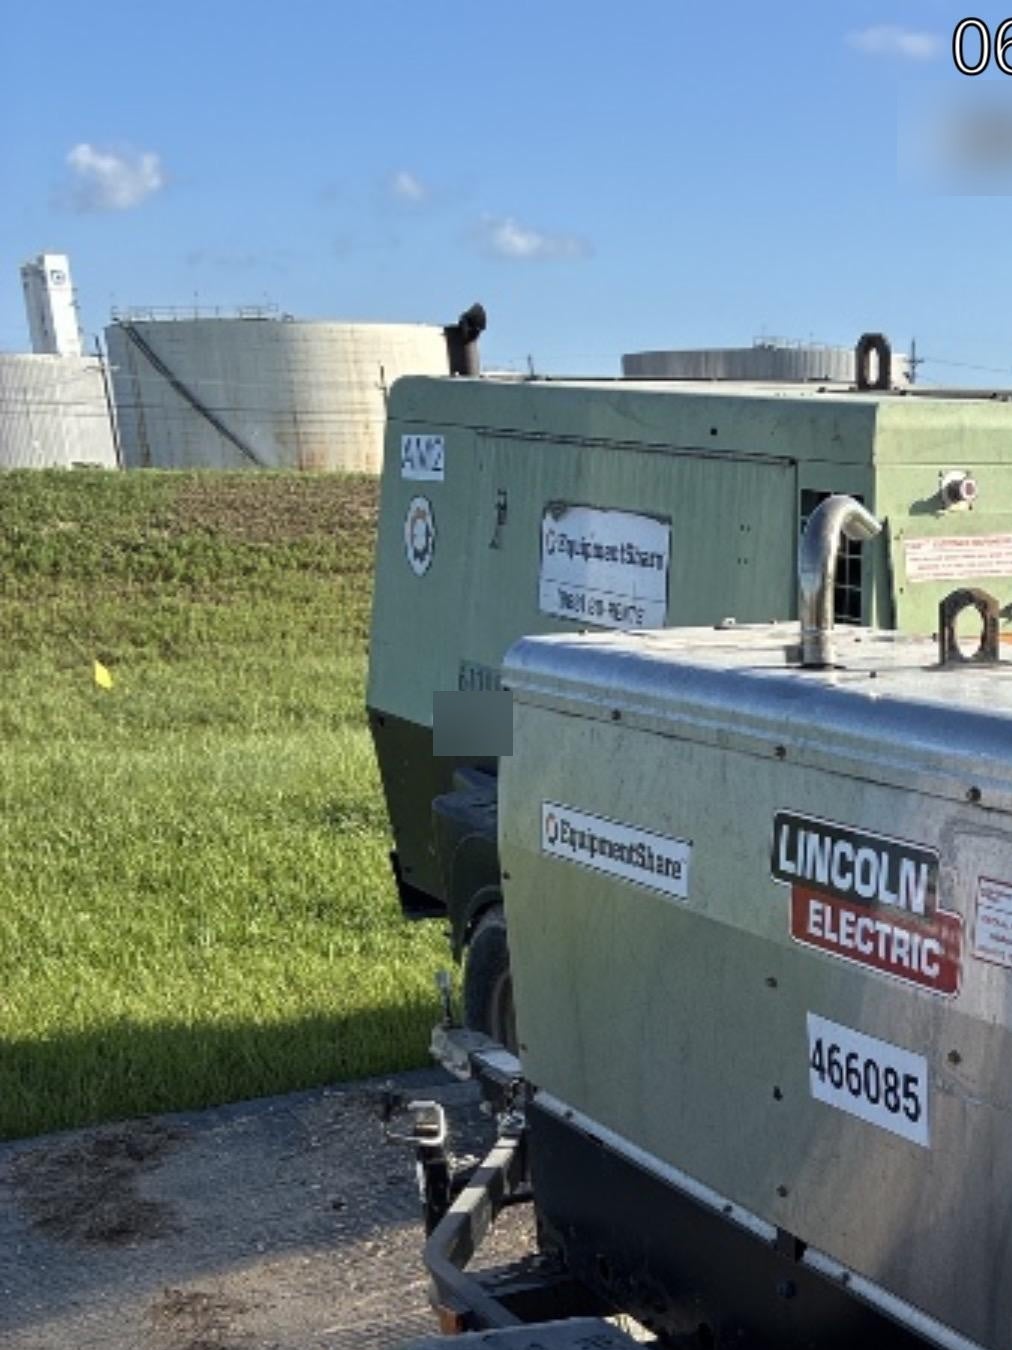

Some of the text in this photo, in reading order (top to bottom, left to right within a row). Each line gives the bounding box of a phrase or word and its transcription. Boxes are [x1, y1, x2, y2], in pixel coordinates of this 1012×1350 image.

[560, 818, 682, 880] EquipmentShare
[778, 824, 928, 914] LINCOLN
[807, 899, 945, 978] ELECTRIC
[812, 1037, 921, 1123] 466085
